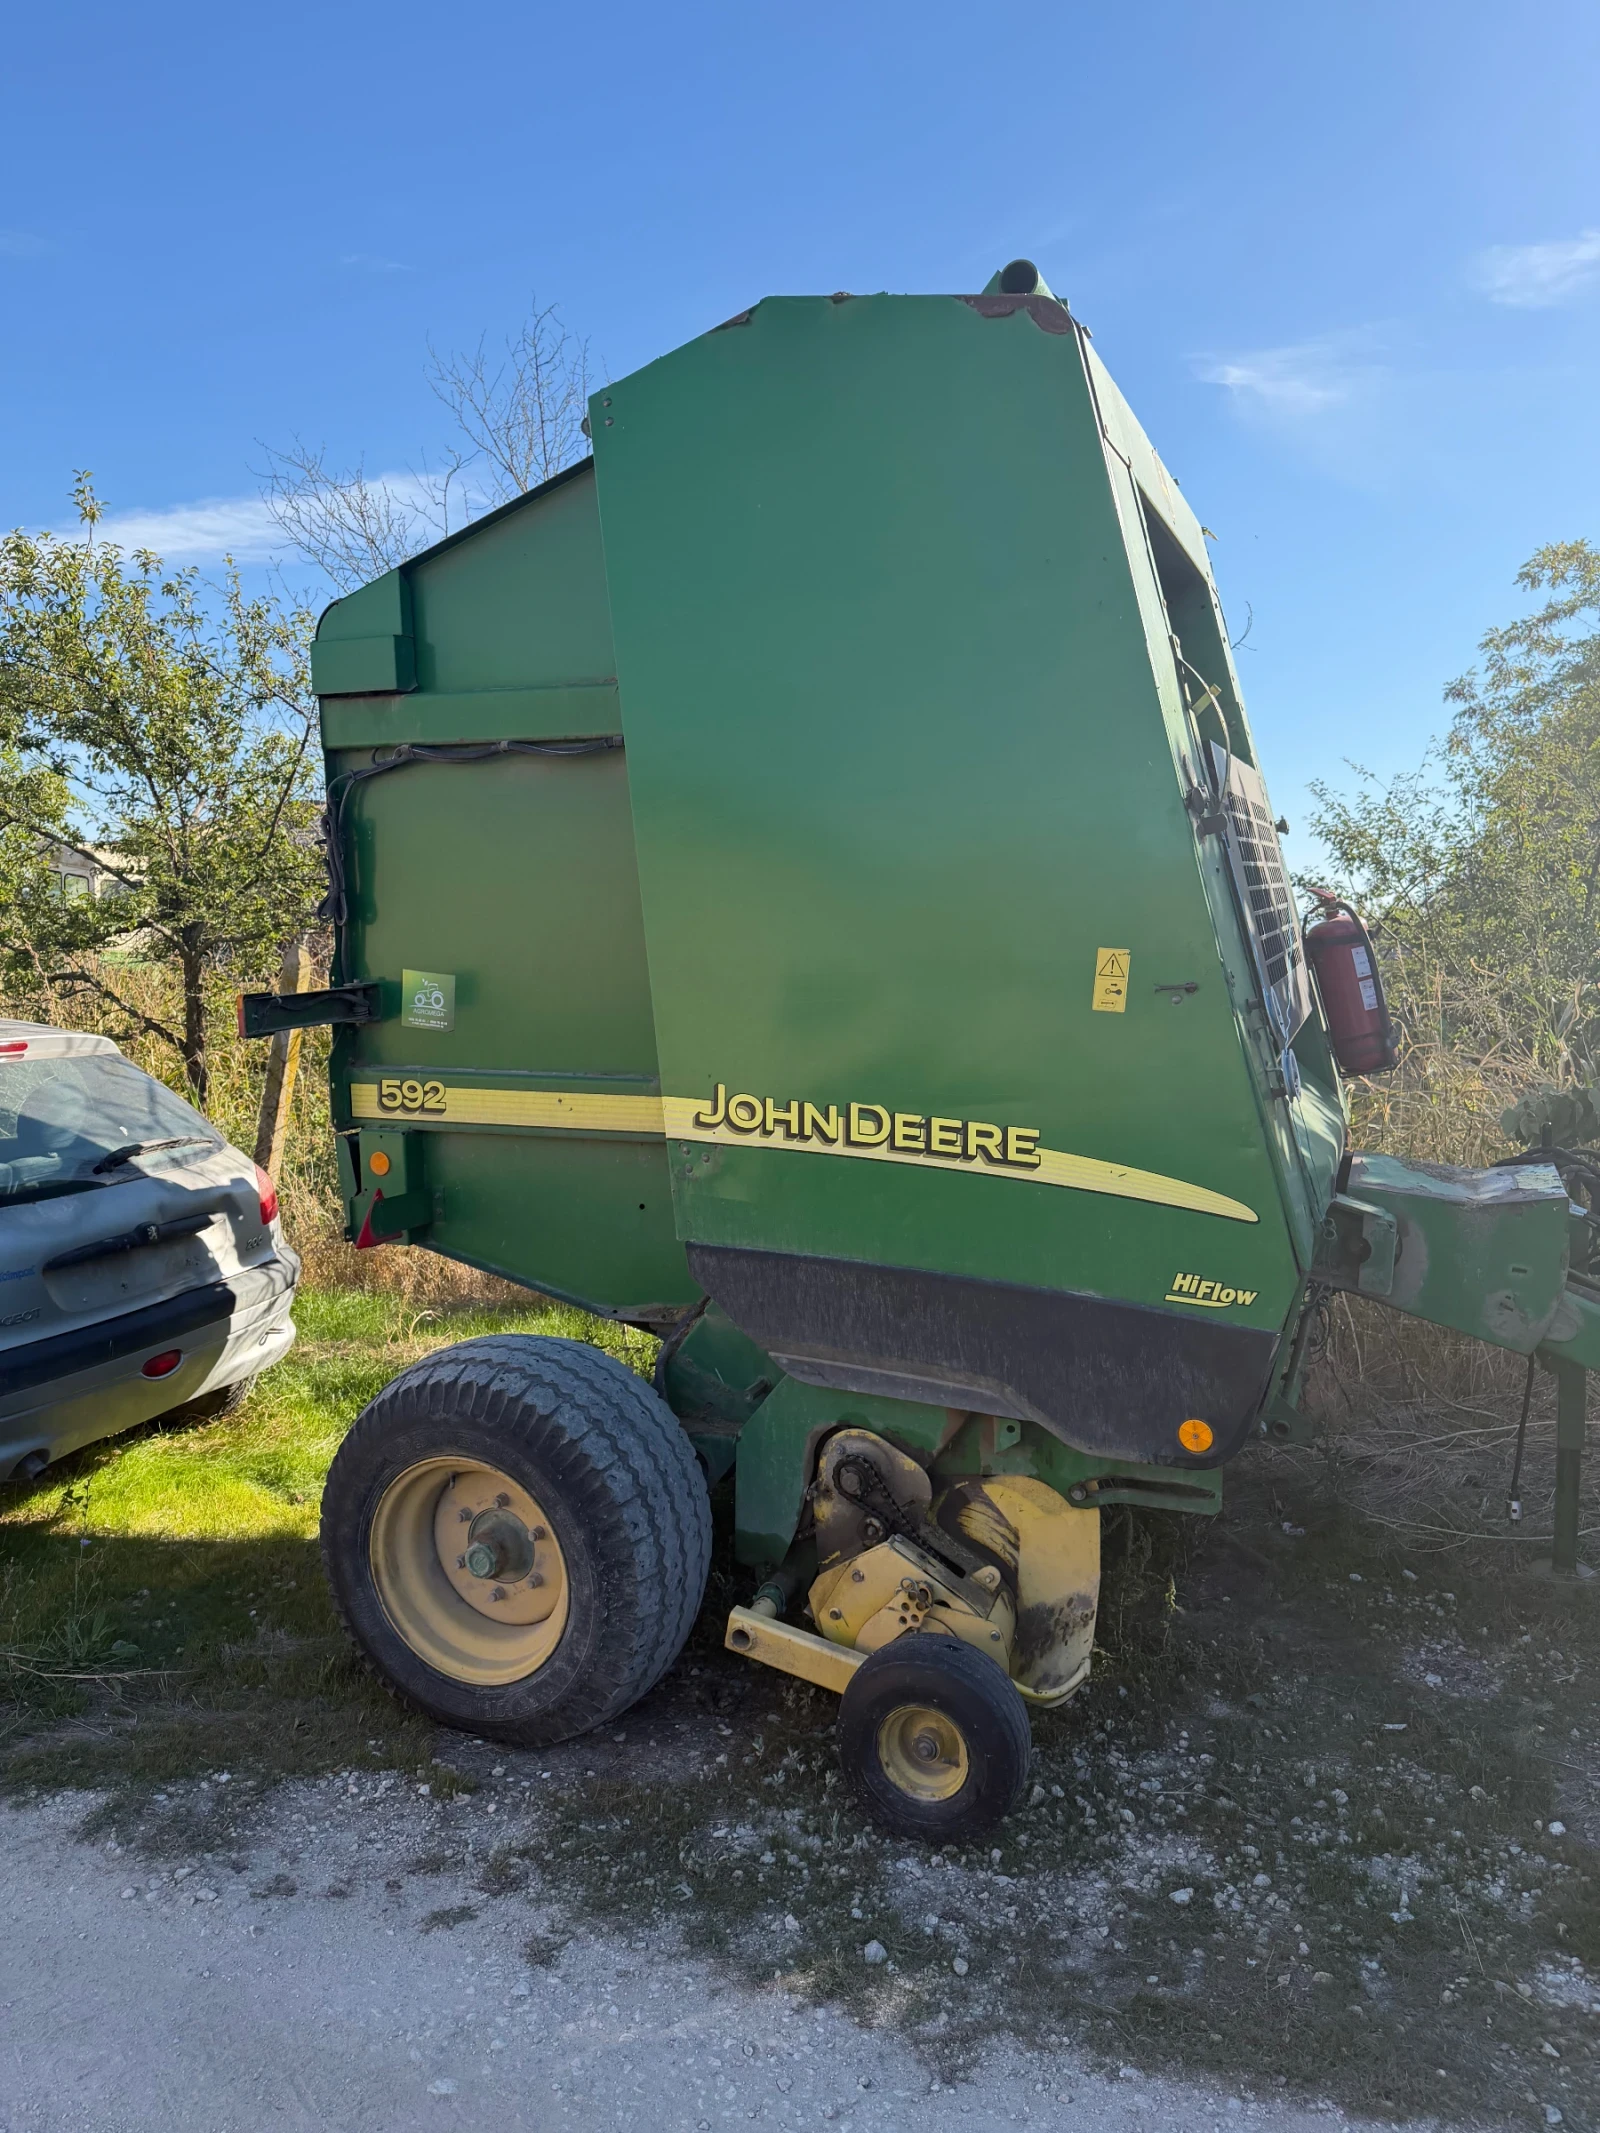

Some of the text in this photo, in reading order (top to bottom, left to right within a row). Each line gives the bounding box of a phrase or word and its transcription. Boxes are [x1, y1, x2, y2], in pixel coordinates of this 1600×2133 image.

[412, 1008, 445, 1017] AGROMEGA
[378, 1079, 447, 1115] 592
[1171, 1272, 1260, 1306] HiFlow
[0, 1306, 43, 1327] GEOT
